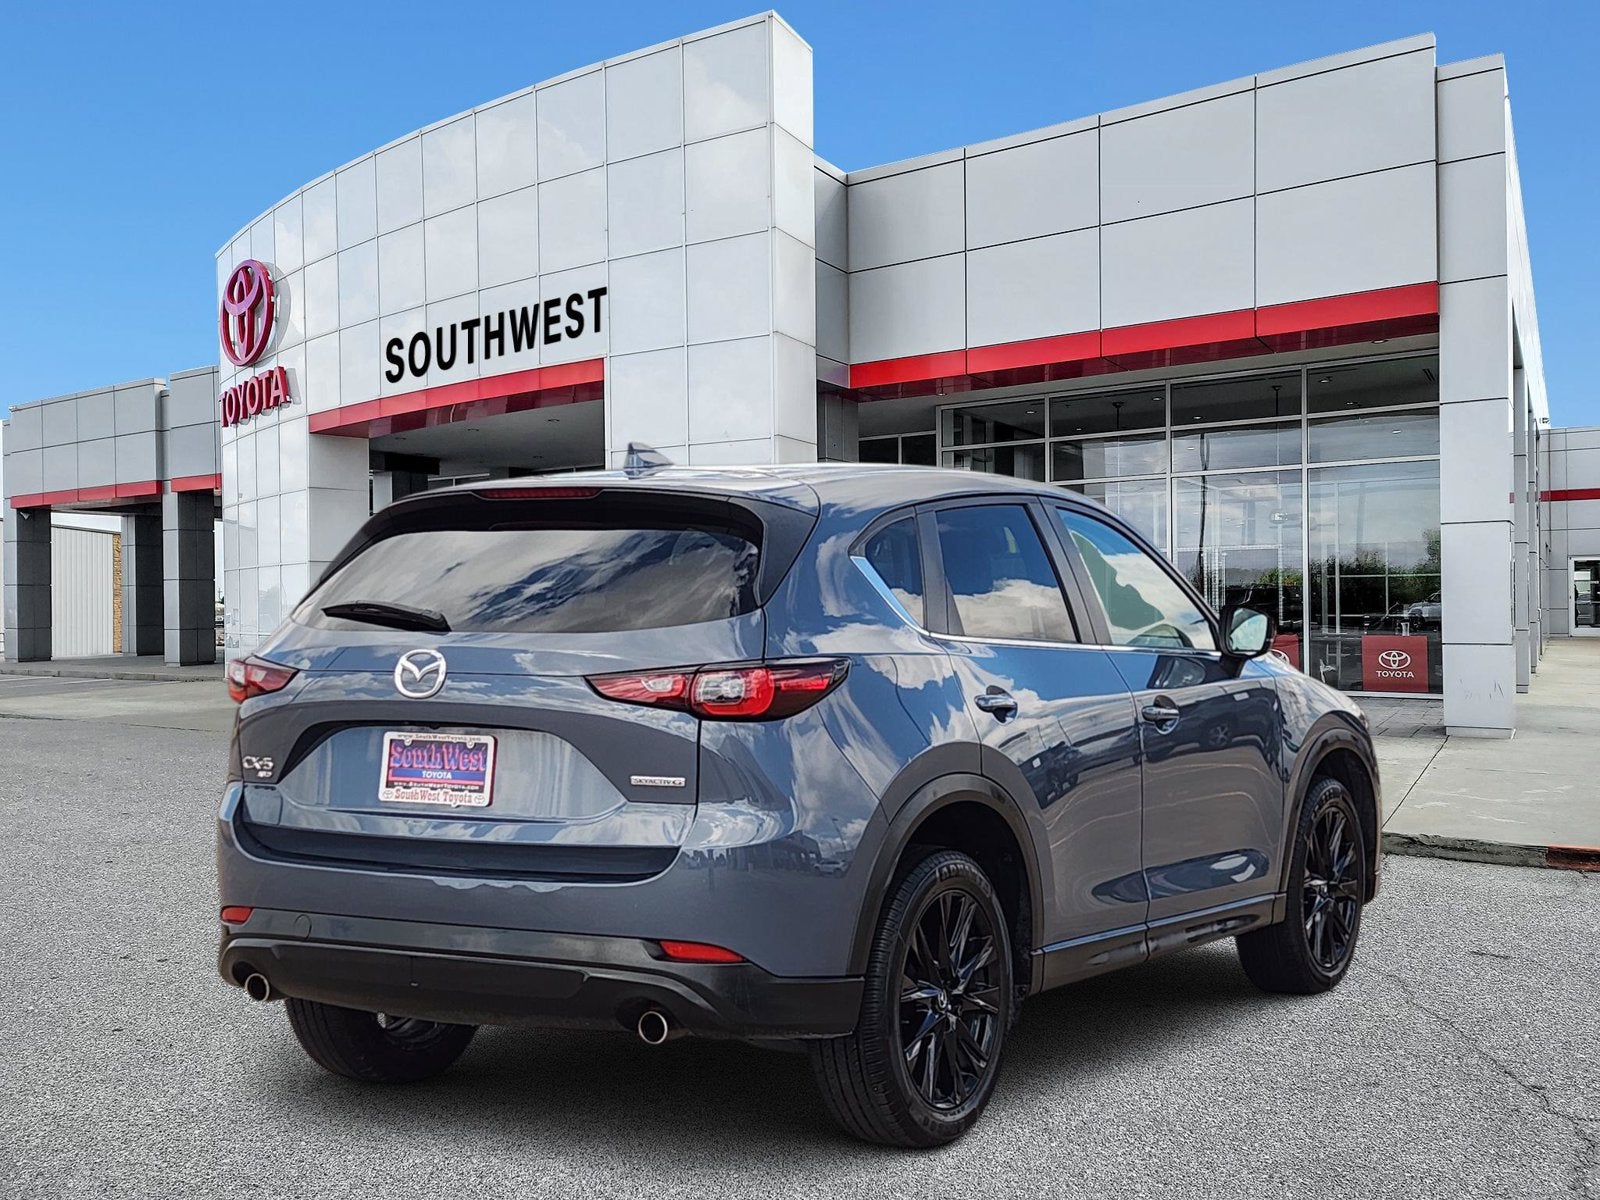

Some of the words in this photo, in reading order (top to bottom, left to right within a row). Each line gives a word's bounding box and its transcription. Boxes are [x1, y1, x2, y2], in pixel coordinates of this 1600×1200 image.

[385, 286, 608, 384] SOUTHWEST
[217, 365, 289, 428] TOYOTA
[1376, 670, 1414, 678] TOYOTA
[242, 755, 274, 770] CX-5
[422, 770, 452, 779] TOYOTA
[443, 791, 472, 804] Toyota
